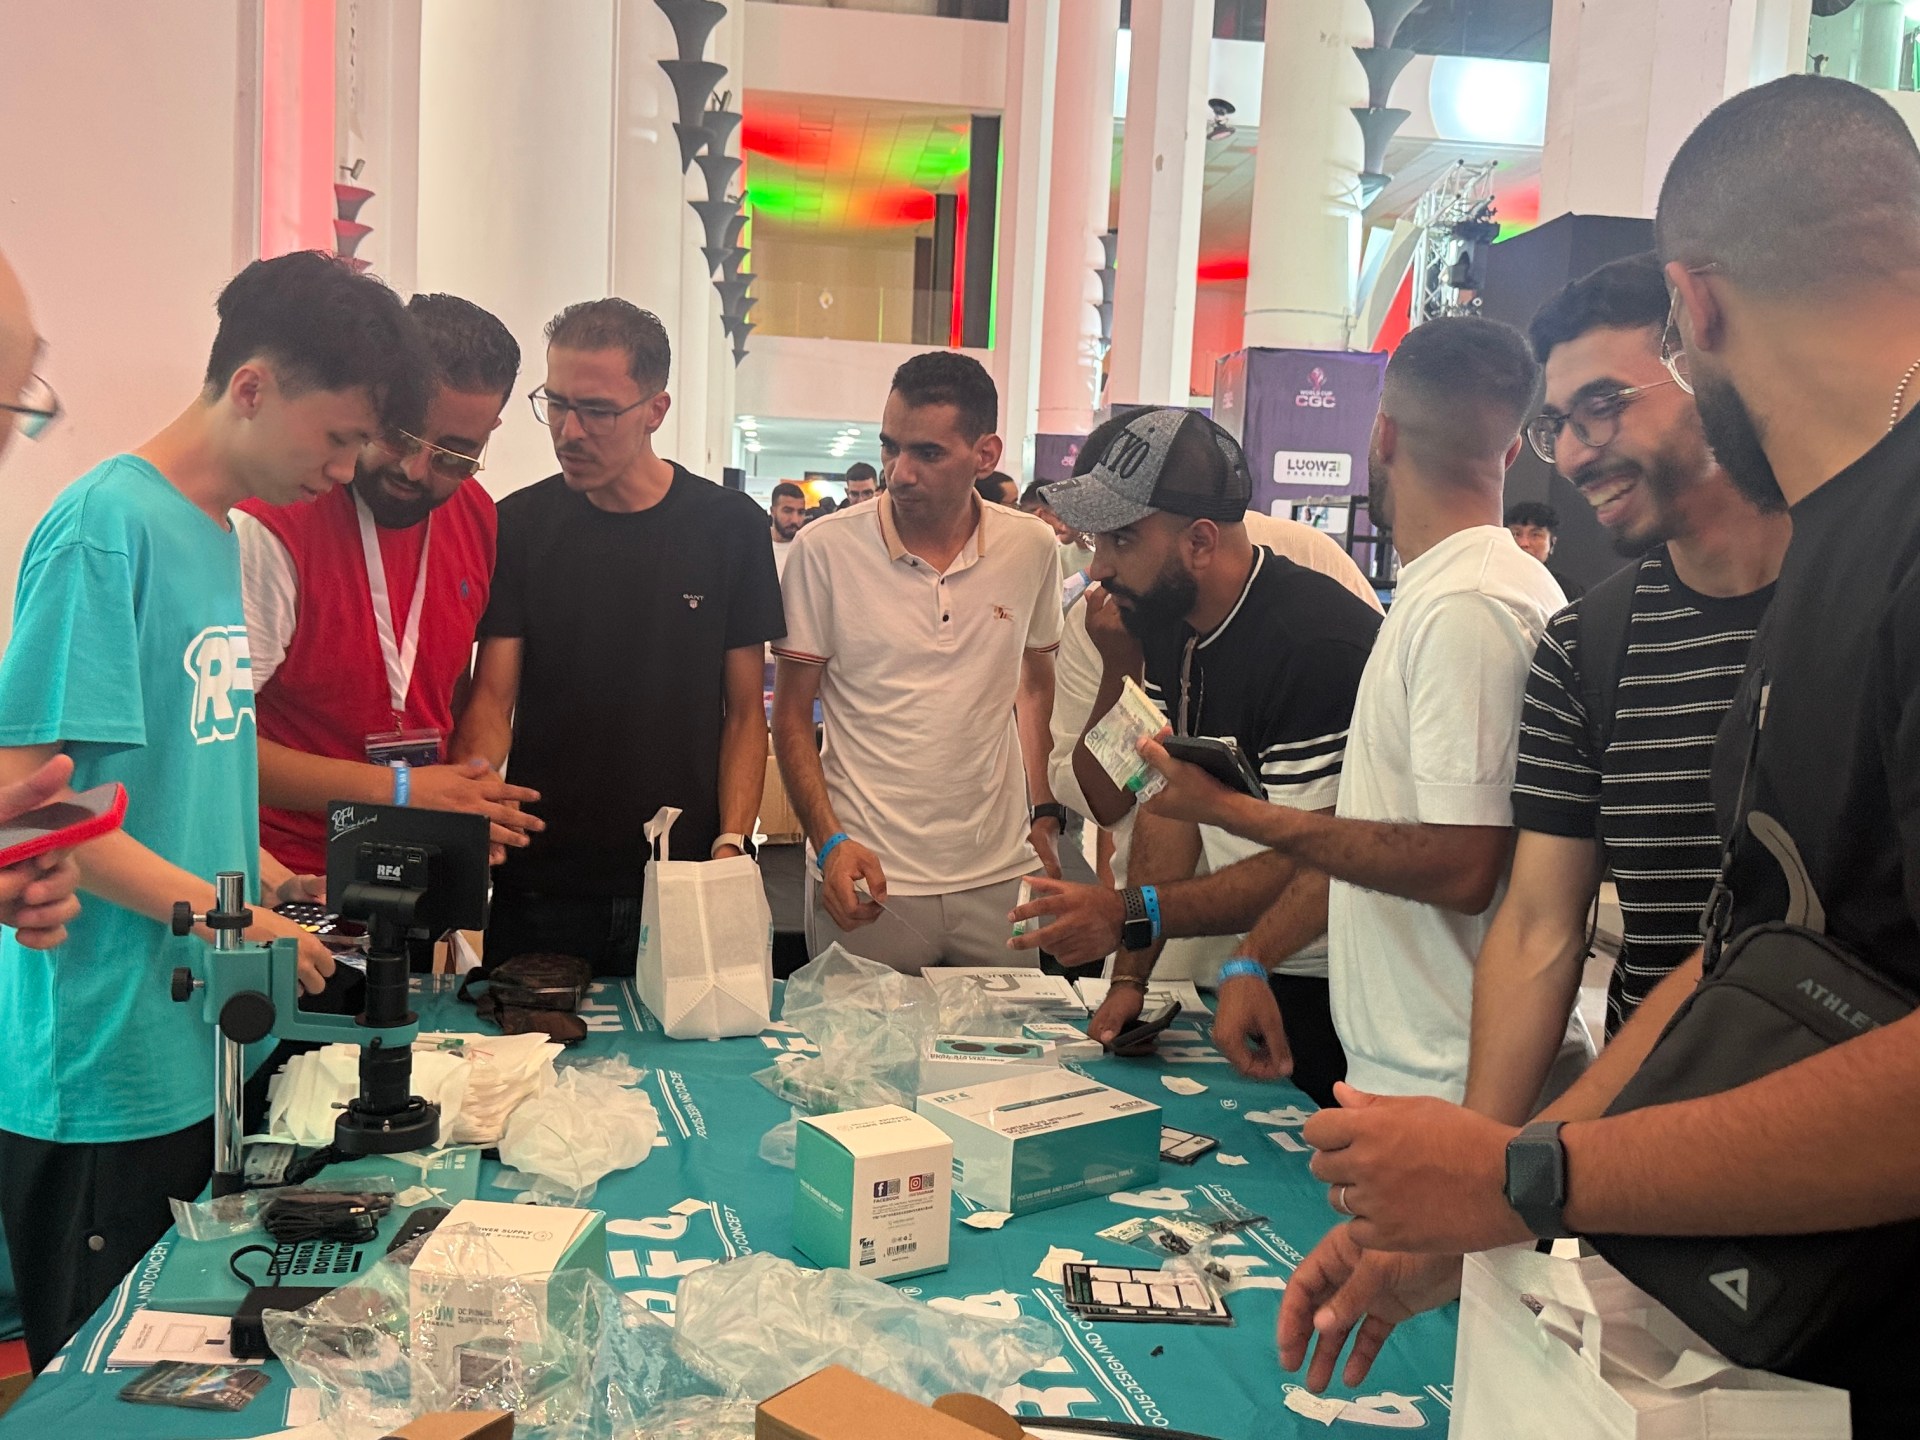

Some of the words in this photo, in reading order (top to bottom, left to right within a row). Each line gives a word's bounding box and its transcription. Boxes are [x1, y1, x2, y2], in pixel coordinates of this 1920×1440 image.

[1295, 395, 1337, 408] CGC
[376, 864, 402, 877] RF4
[1797, 978, 1880, 1031] ATHLE
[873, 1195, 900, 1203] FACEBOOK
[723, 1204, 749, 1246] CONCEPT
[1084, 1332, 1111, 1358] AND
[1133, 1392, 1169, 1428] OCUS
